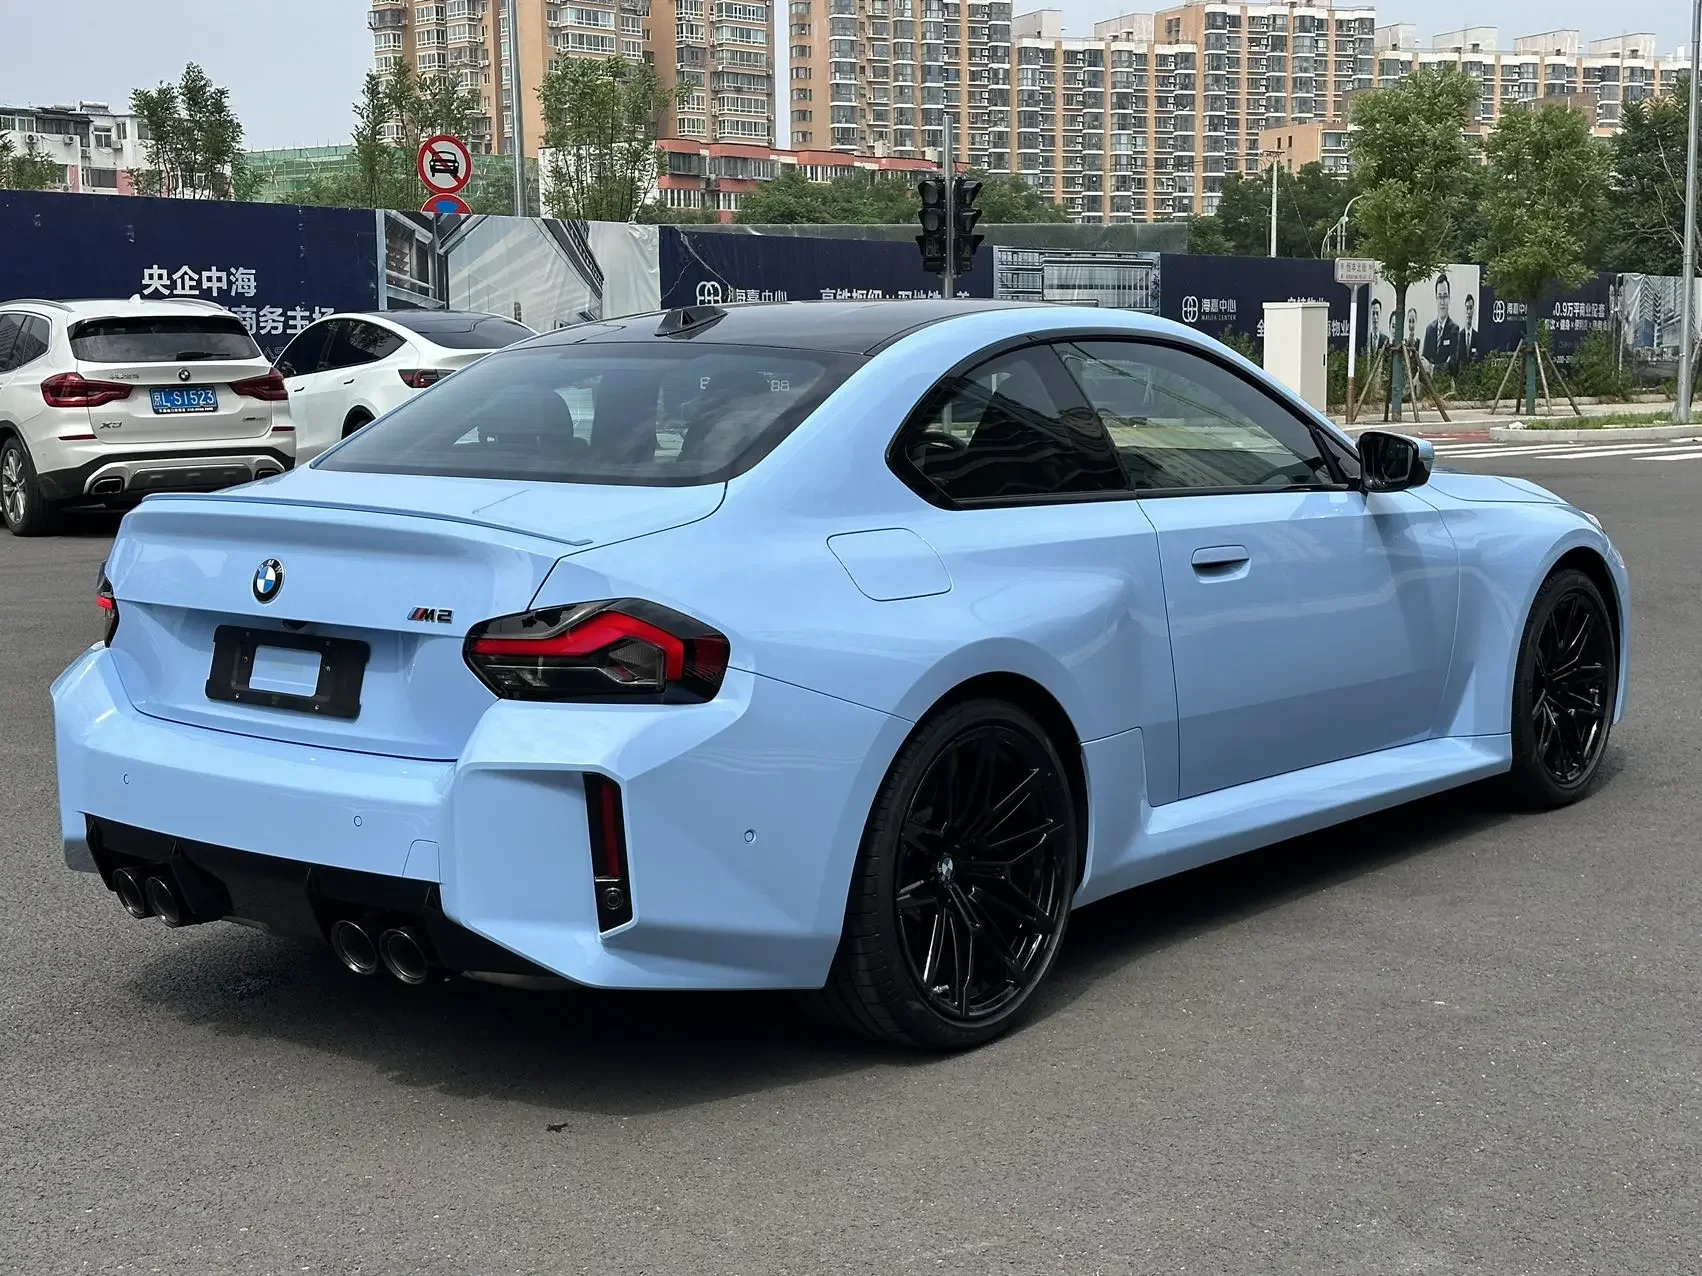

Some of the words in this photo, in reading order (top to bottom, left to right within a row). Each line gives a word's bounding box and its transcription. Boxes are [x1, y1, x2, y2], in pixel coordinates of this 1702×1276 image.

[141, 265, 257, 297] 央企中海
[407, 606, 453, 624] M2
